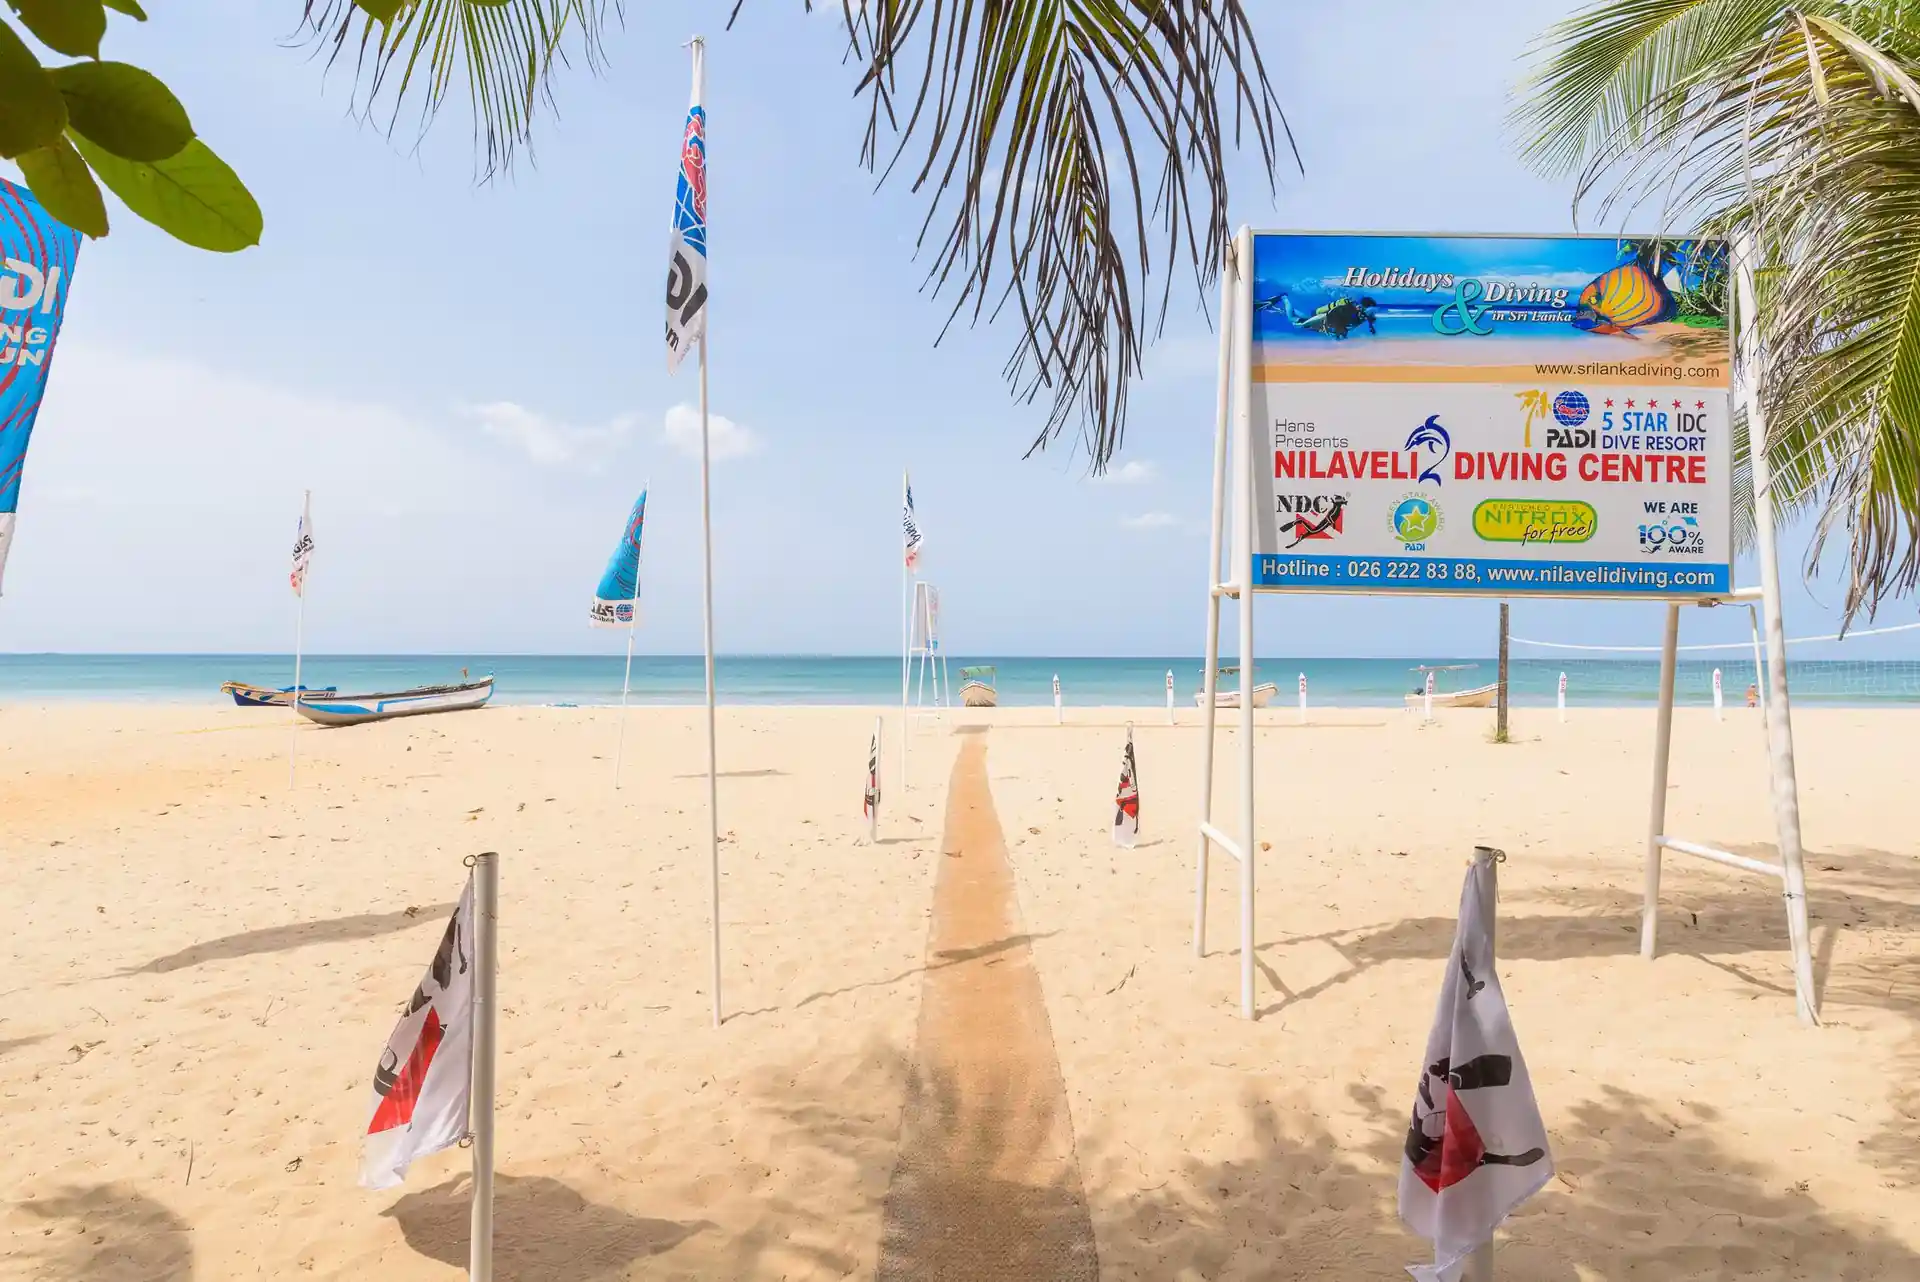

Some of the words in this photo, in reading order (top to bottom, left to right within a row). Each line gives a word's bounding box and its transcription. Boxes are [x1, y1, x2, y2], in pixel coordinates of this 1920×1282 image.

[1342, 267, 1454, 293] Holidays
[1431, 279, 1493, 335] &
[1483, 281, 1569, 308] Diving
[1492, 311, 1504, 321] in
[1508, 311, 1528, 321] Sri
[1532, 312, 1572, 322] Lanka
[1535, 362, 1720, 380] www.srilankadiving.com
[1275, 419, 1315, 432] Hans
[1602, 412, 1613, 431] 5
[1623, 412, 1668, 432] STAR
[1677, 413, 1707, 433] IDC
[1275, 434, 1349, 448] Presents
[1547, 429, 1596, 448] PADI
[1602, 435, 1640, 450] DIVE
[1646, 436, 1706, 451] RESORT
[1275, 450, 1418, 479] NILAVELI
[1454, 452, 1567, 482] DIVING
[1579, 453, 1707, 484] CENTRE
[1276, 495, 1328, 513] NDC
[1644, 502, 1666, 513] WE
[1670, 503, 1698, 514] ARE
[1485, 510, 1587, 525] NITROX
[1522, 524, 1547, 546] for
[1549, 520, 1593, 544] free!
[1638, 525, 1704, 545] 100%
[1404, 543, 1425, 551] PADI
[1668, 546, 1704, 554] AWARE
[1262, 559, 1330, 576] Hotline
[1348, 561, 1381, 577] 026
[1386, 561, 1420, 579] 222
[1426, 562, 1448, 580] 83
[1454, 563, 1481, 583] 88,
[1487, 565, 1715, 588] www.nilavelidiving.com
